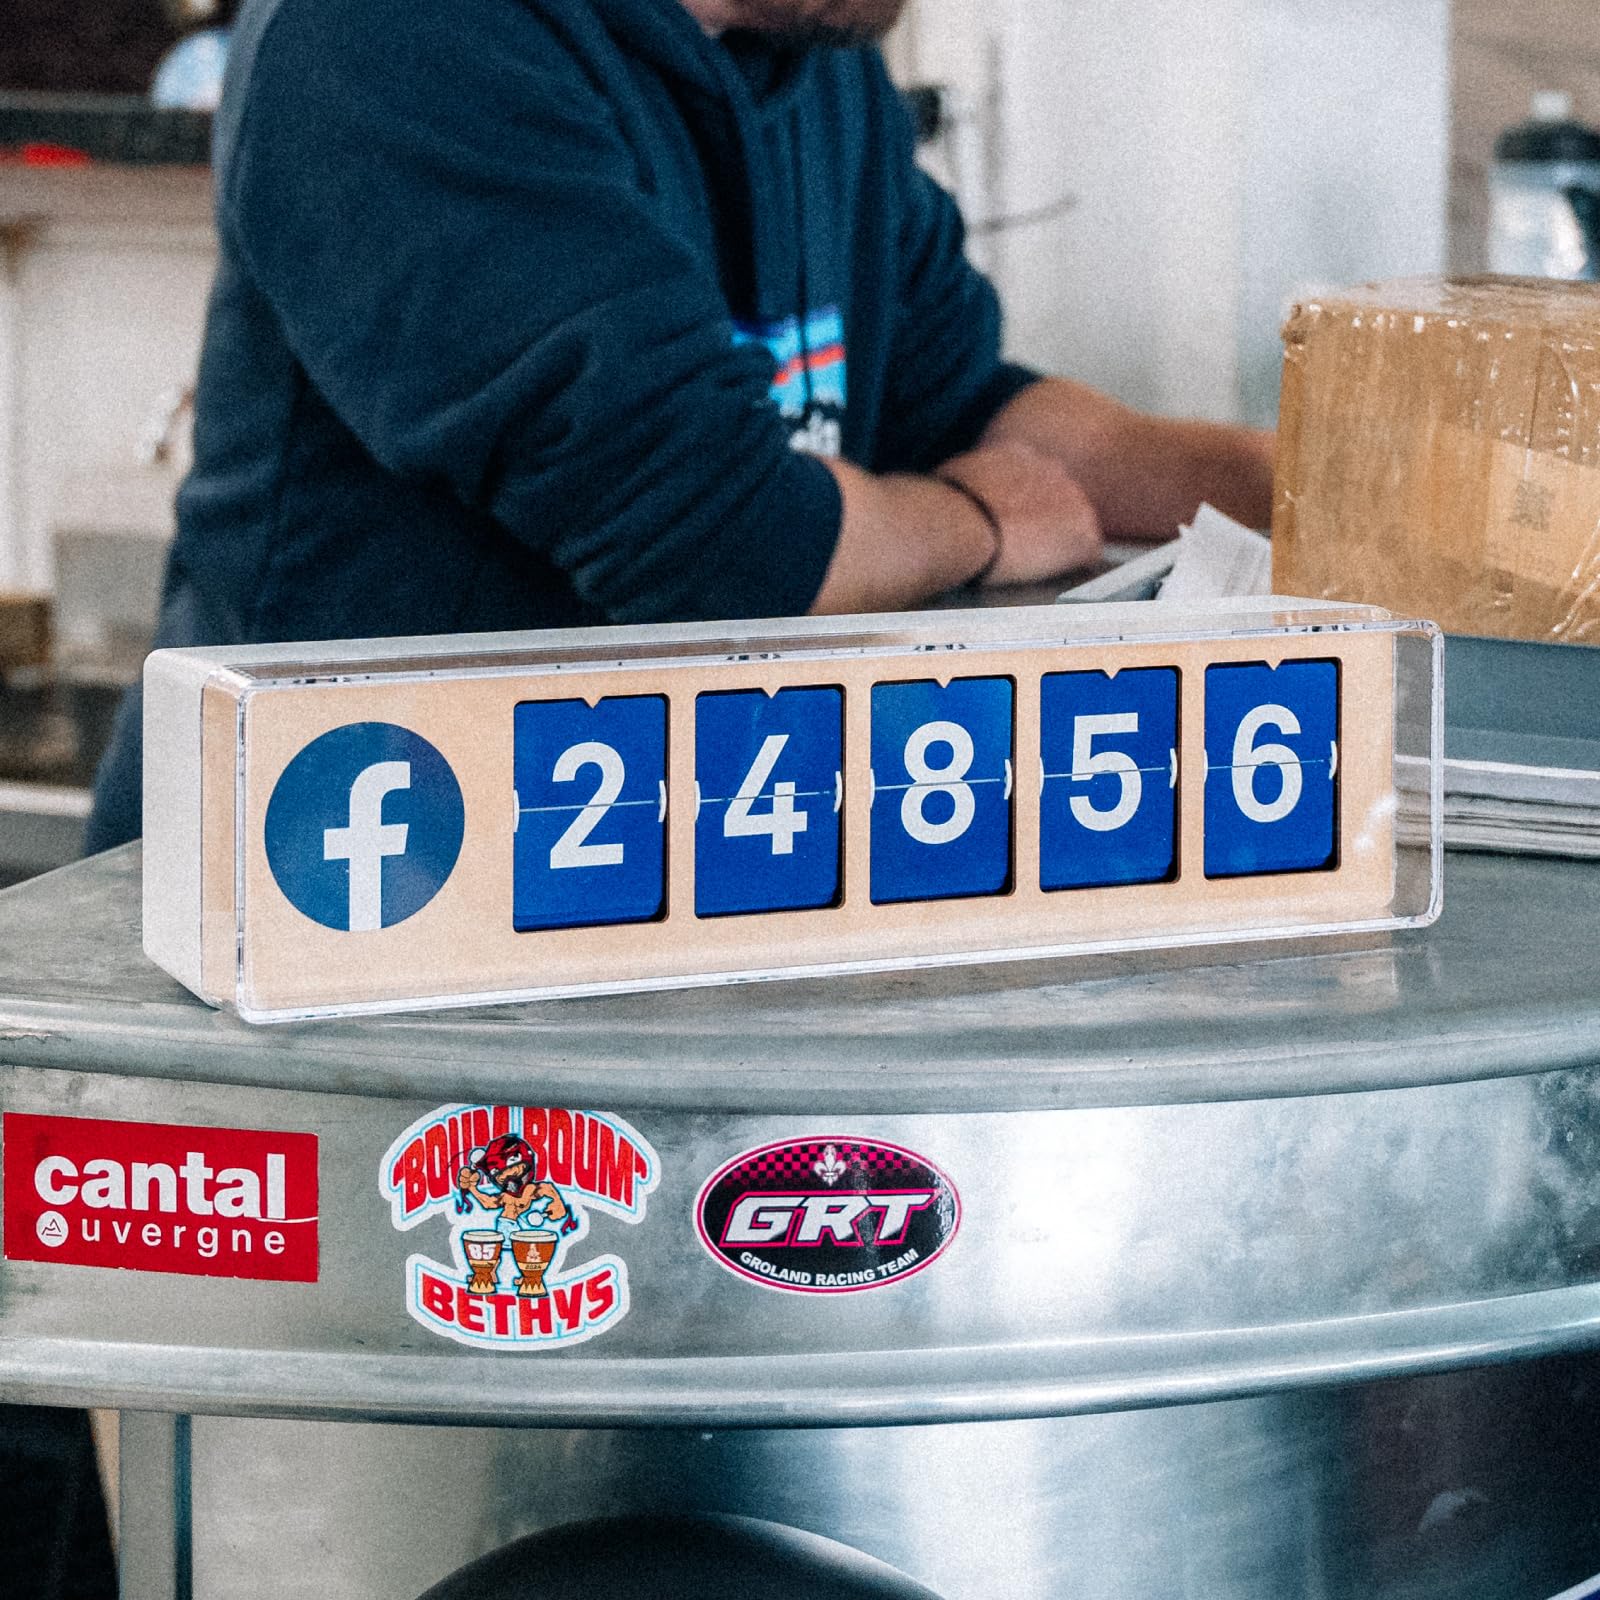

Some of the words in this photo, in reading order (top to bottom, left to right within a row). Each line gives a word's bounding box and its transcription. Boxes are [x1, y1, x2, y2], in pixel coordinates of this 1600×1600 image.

[33, 1151, 287, 1221] cantal
[523, 1106, 648, 1207] BOUM
[722, 1192, 936, 1245] GRT
[467, 1243, 497, 1261] 85
[739, 1250, 811, 1286] GROLAND
[815, 1268, 876, 1287] RACING
[876, 1247, 920, 1277] TEAM
[421, 1269, 614, 1336] BETHYS
